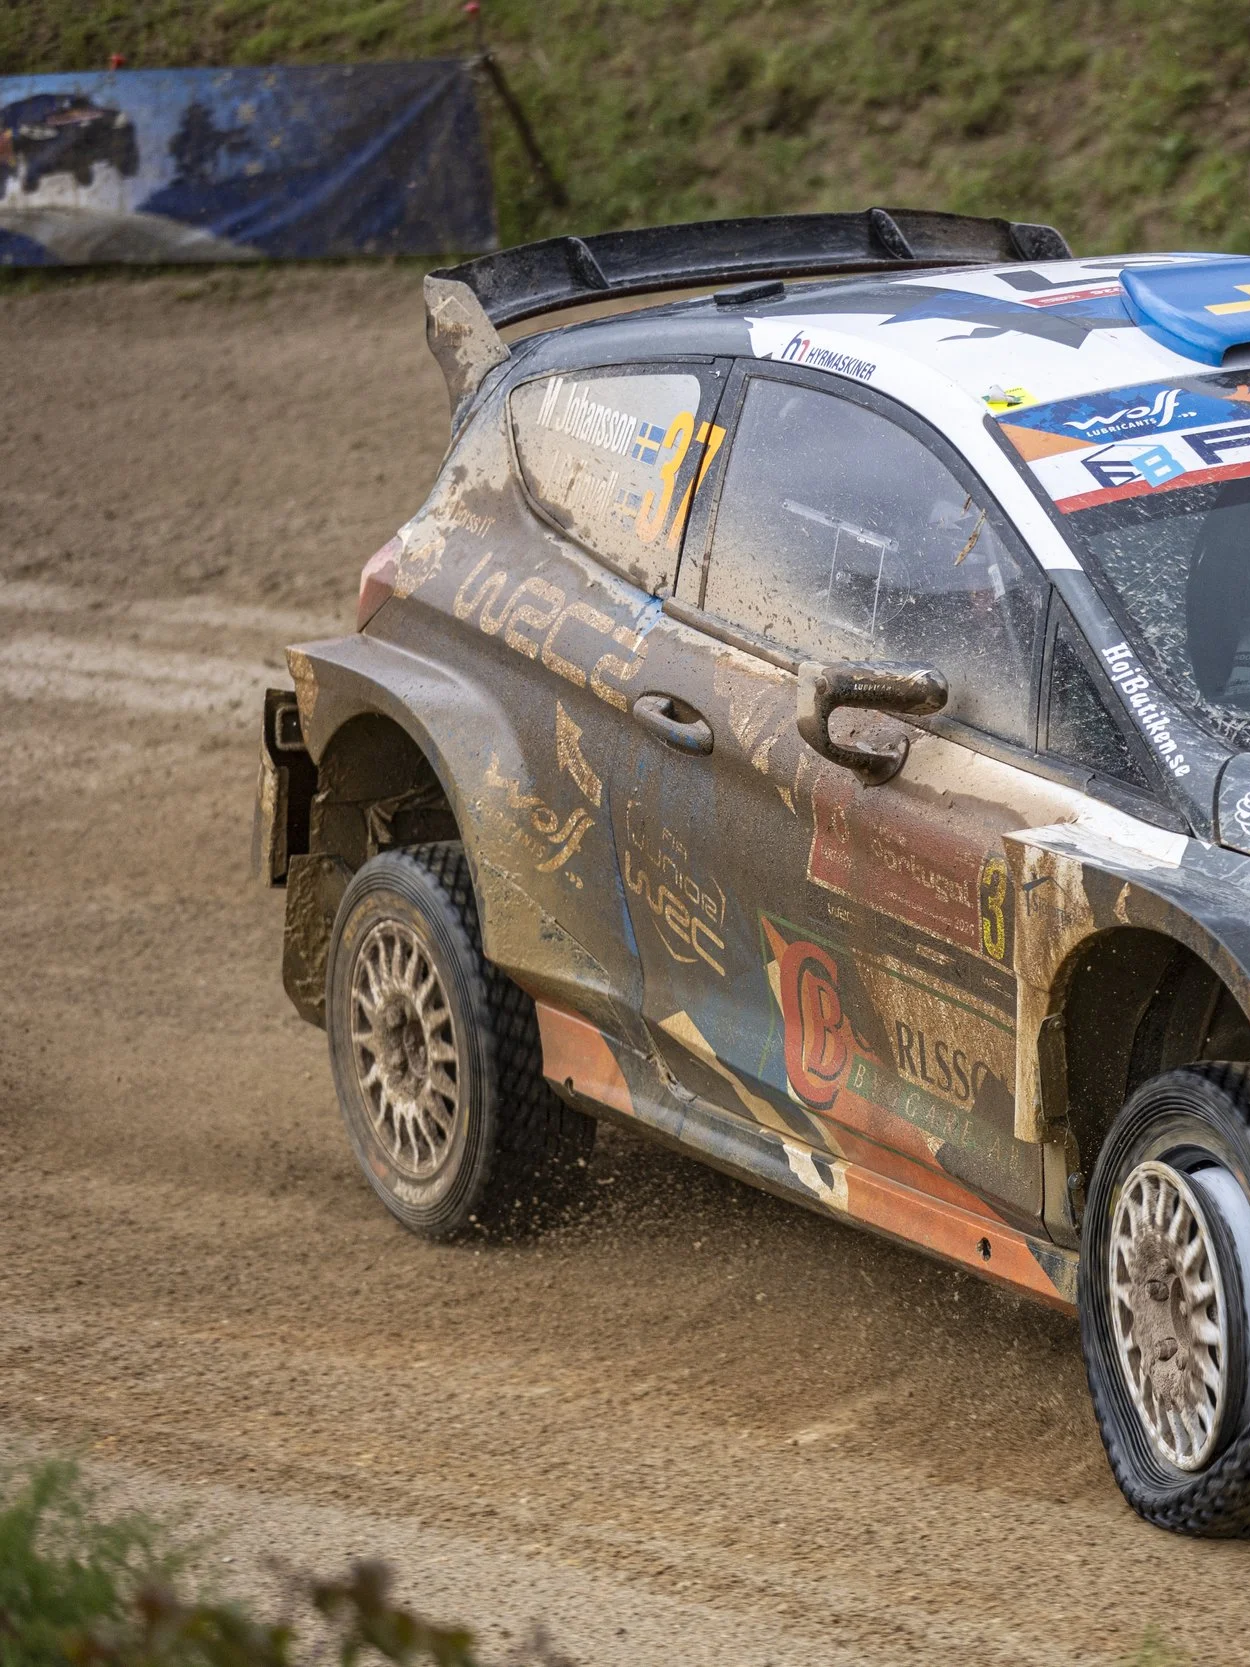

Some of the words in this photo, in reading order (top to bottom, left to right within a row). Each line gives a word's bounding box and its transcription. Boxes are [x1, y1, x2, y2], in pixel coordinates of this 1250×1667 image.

[805, 347, 877, 382] HYRMASKINER
[555, 382, 638, 457] Johansson
[1086, 417, 1157, 438] LUBRICANTS
[635, 411, 727, 552] 37
[453, 552, 649, 713] WRC2
[624, 850, 726, 977] WRC
